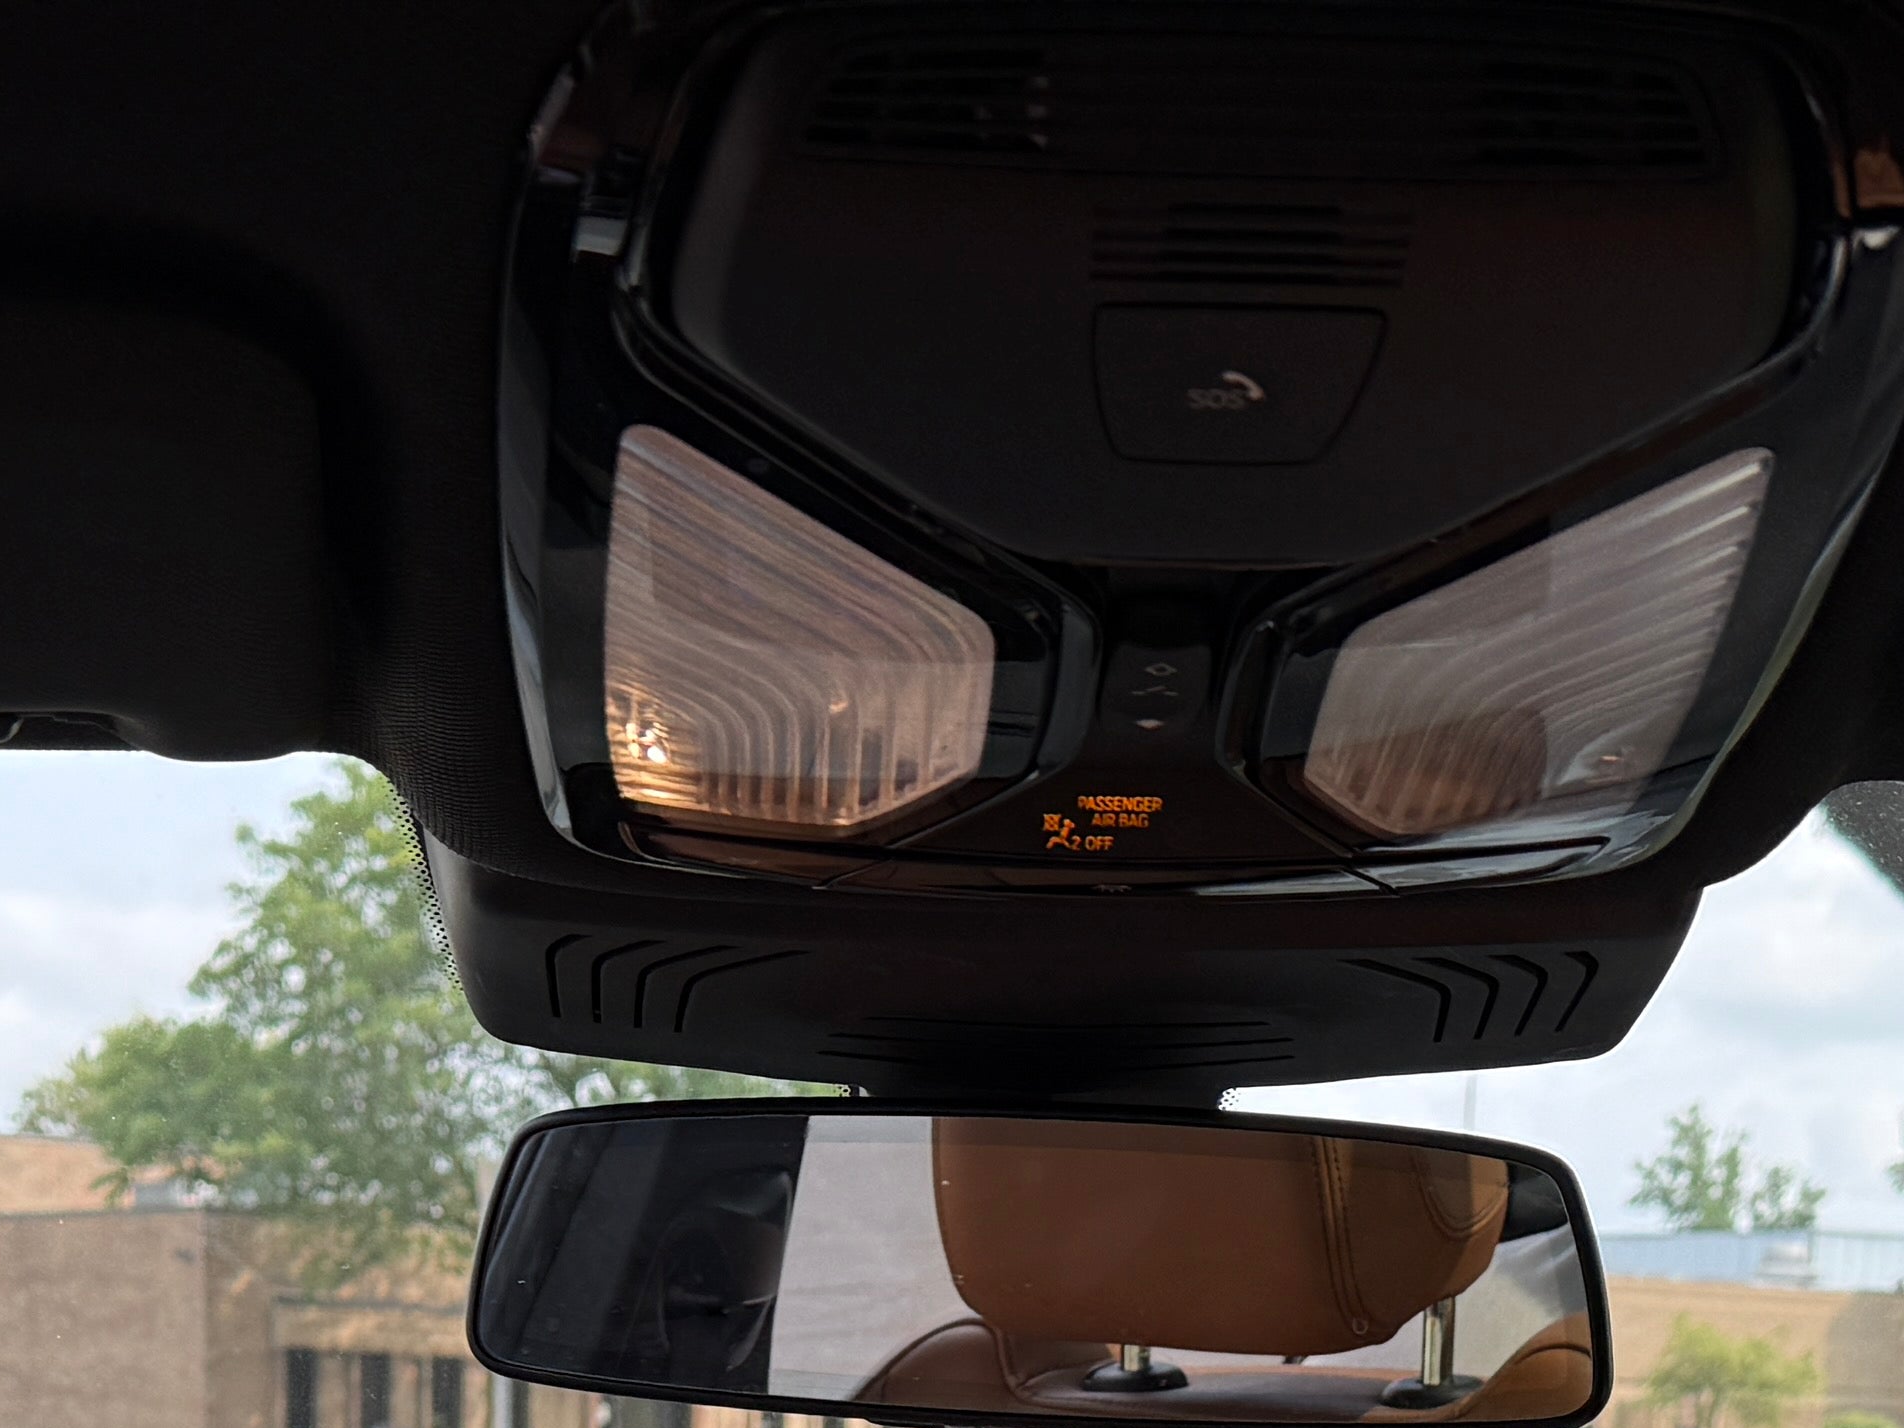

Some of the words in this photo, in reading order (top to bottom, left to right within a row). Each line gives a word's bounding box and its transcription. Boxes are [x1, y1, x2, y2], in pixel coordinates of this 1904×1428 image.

[1077, 795, 1163, 812] PASSENGER
[1091, 812, 1116, 828] AIR
[1118, 812, 1149, 828] BAG
[1084, 835, 1114, 851] OFF
